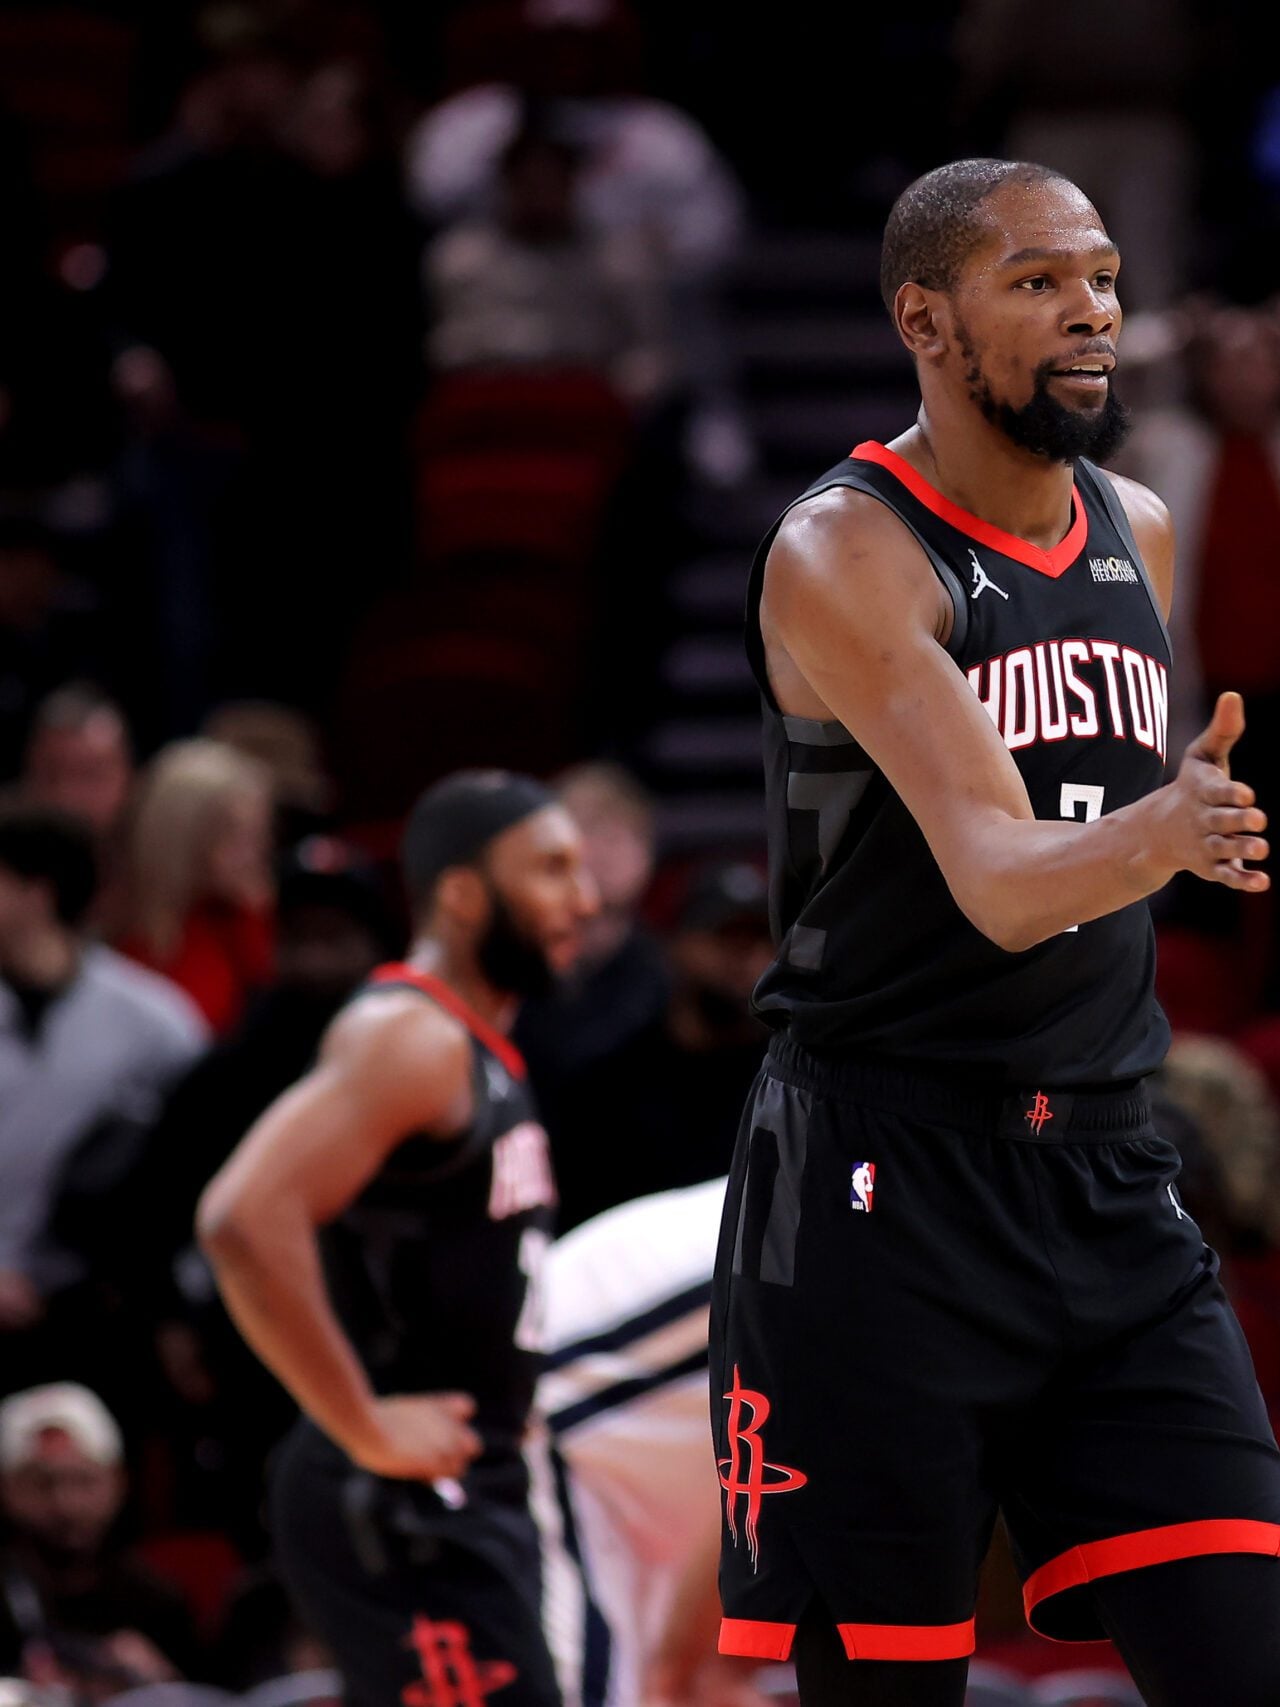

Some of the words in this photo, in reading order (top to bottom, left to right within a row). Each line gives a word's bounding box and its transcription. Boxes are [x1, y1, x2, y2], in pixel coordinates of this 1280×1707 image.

[1088, 556, 1133, 571] MEMORIAL
[1091, 569, 1138, 582] HERMANN
[965, 637, 1169, 768] HOUSTON
